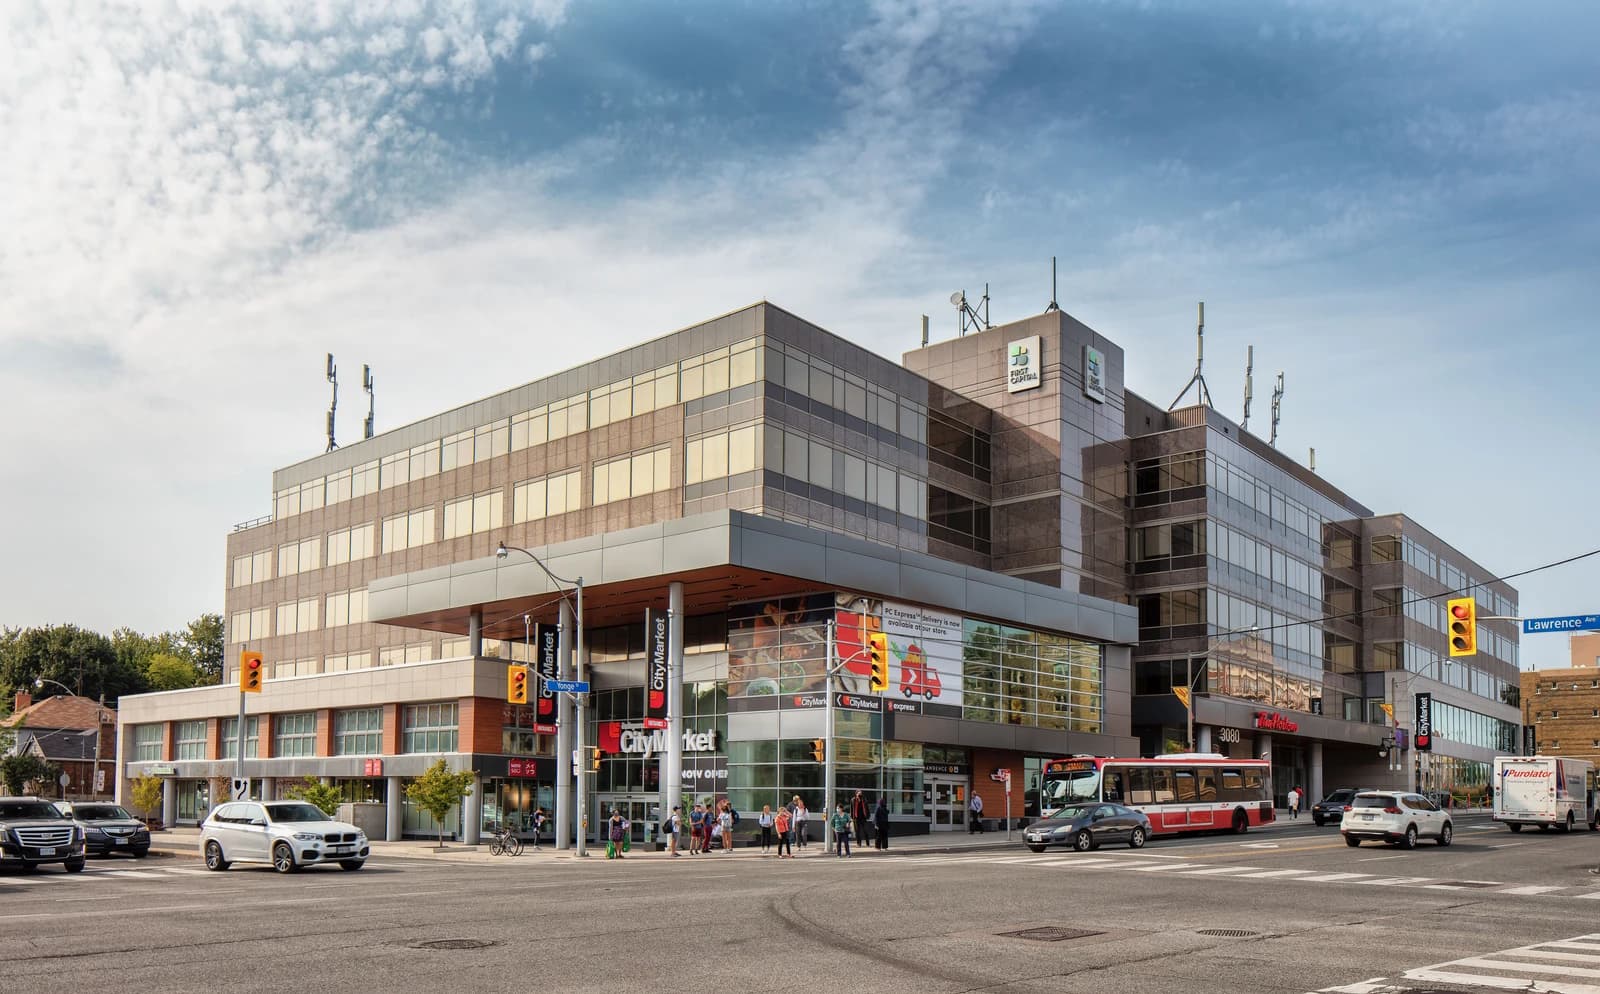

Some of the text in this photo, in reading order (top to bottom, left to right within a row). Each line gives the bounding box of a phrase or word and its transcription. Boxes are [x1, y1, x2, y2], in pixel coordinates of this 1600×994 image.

[1010, 367, 1029, 377] FIRST
[1010, 372, 1038, 385] CAPITAL
[885, 607, 893, 615] PC
[922, 615, 943, 625] delivery
[888, 620, 914, 629] available
[1527, 619, 1582, 630] Lawrence
[653, 617, 666, 690] CityMarket
[557, 682, 575, 691] Yonge
[849, 698, 878, 710] CityMarket
[1420, 697, 1429, 735] CityMarket
[1219, 727, 1240, 743] 3080
[1508, 769, 1552, 778] Purolator
